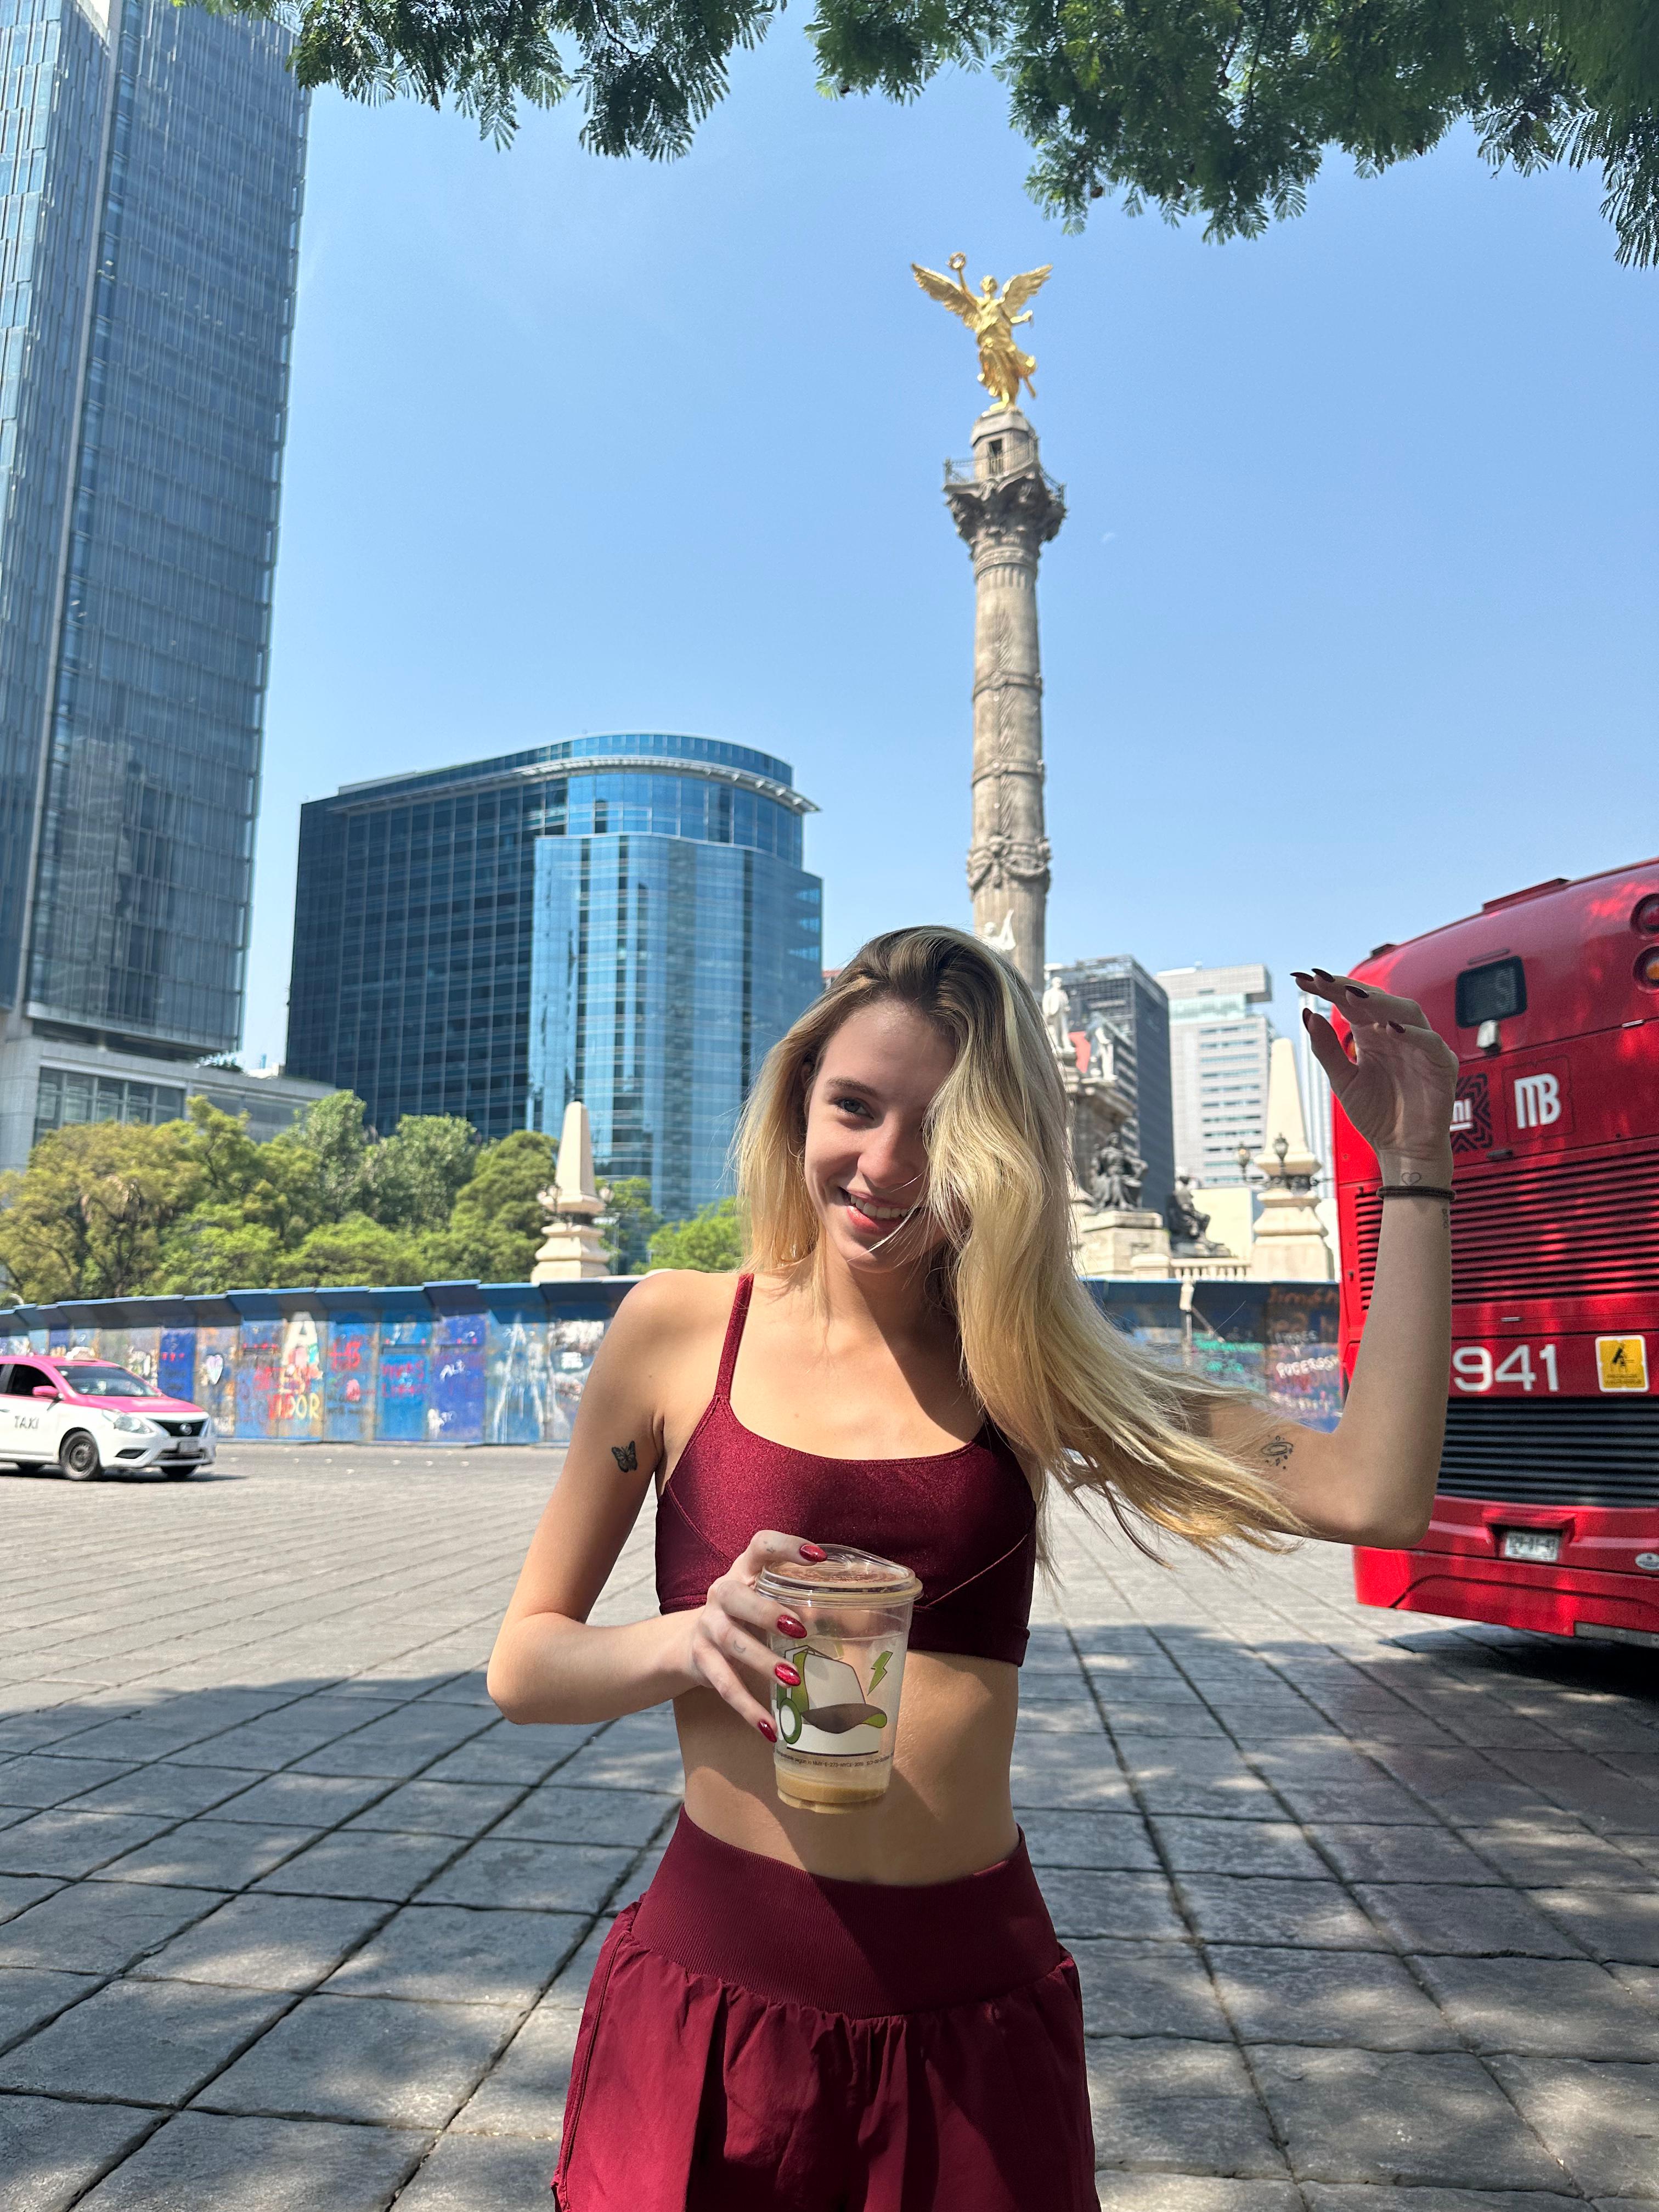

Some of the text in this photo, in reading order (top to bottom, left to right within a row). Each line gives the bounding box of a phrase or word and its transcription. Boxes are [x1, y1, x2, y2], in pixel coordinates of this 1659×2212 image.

[1514, 1073, 1561, 1130] MB
[1453, 1344, 1559, 1392] 941
[14, 1415, 39, 1429] TAXI
